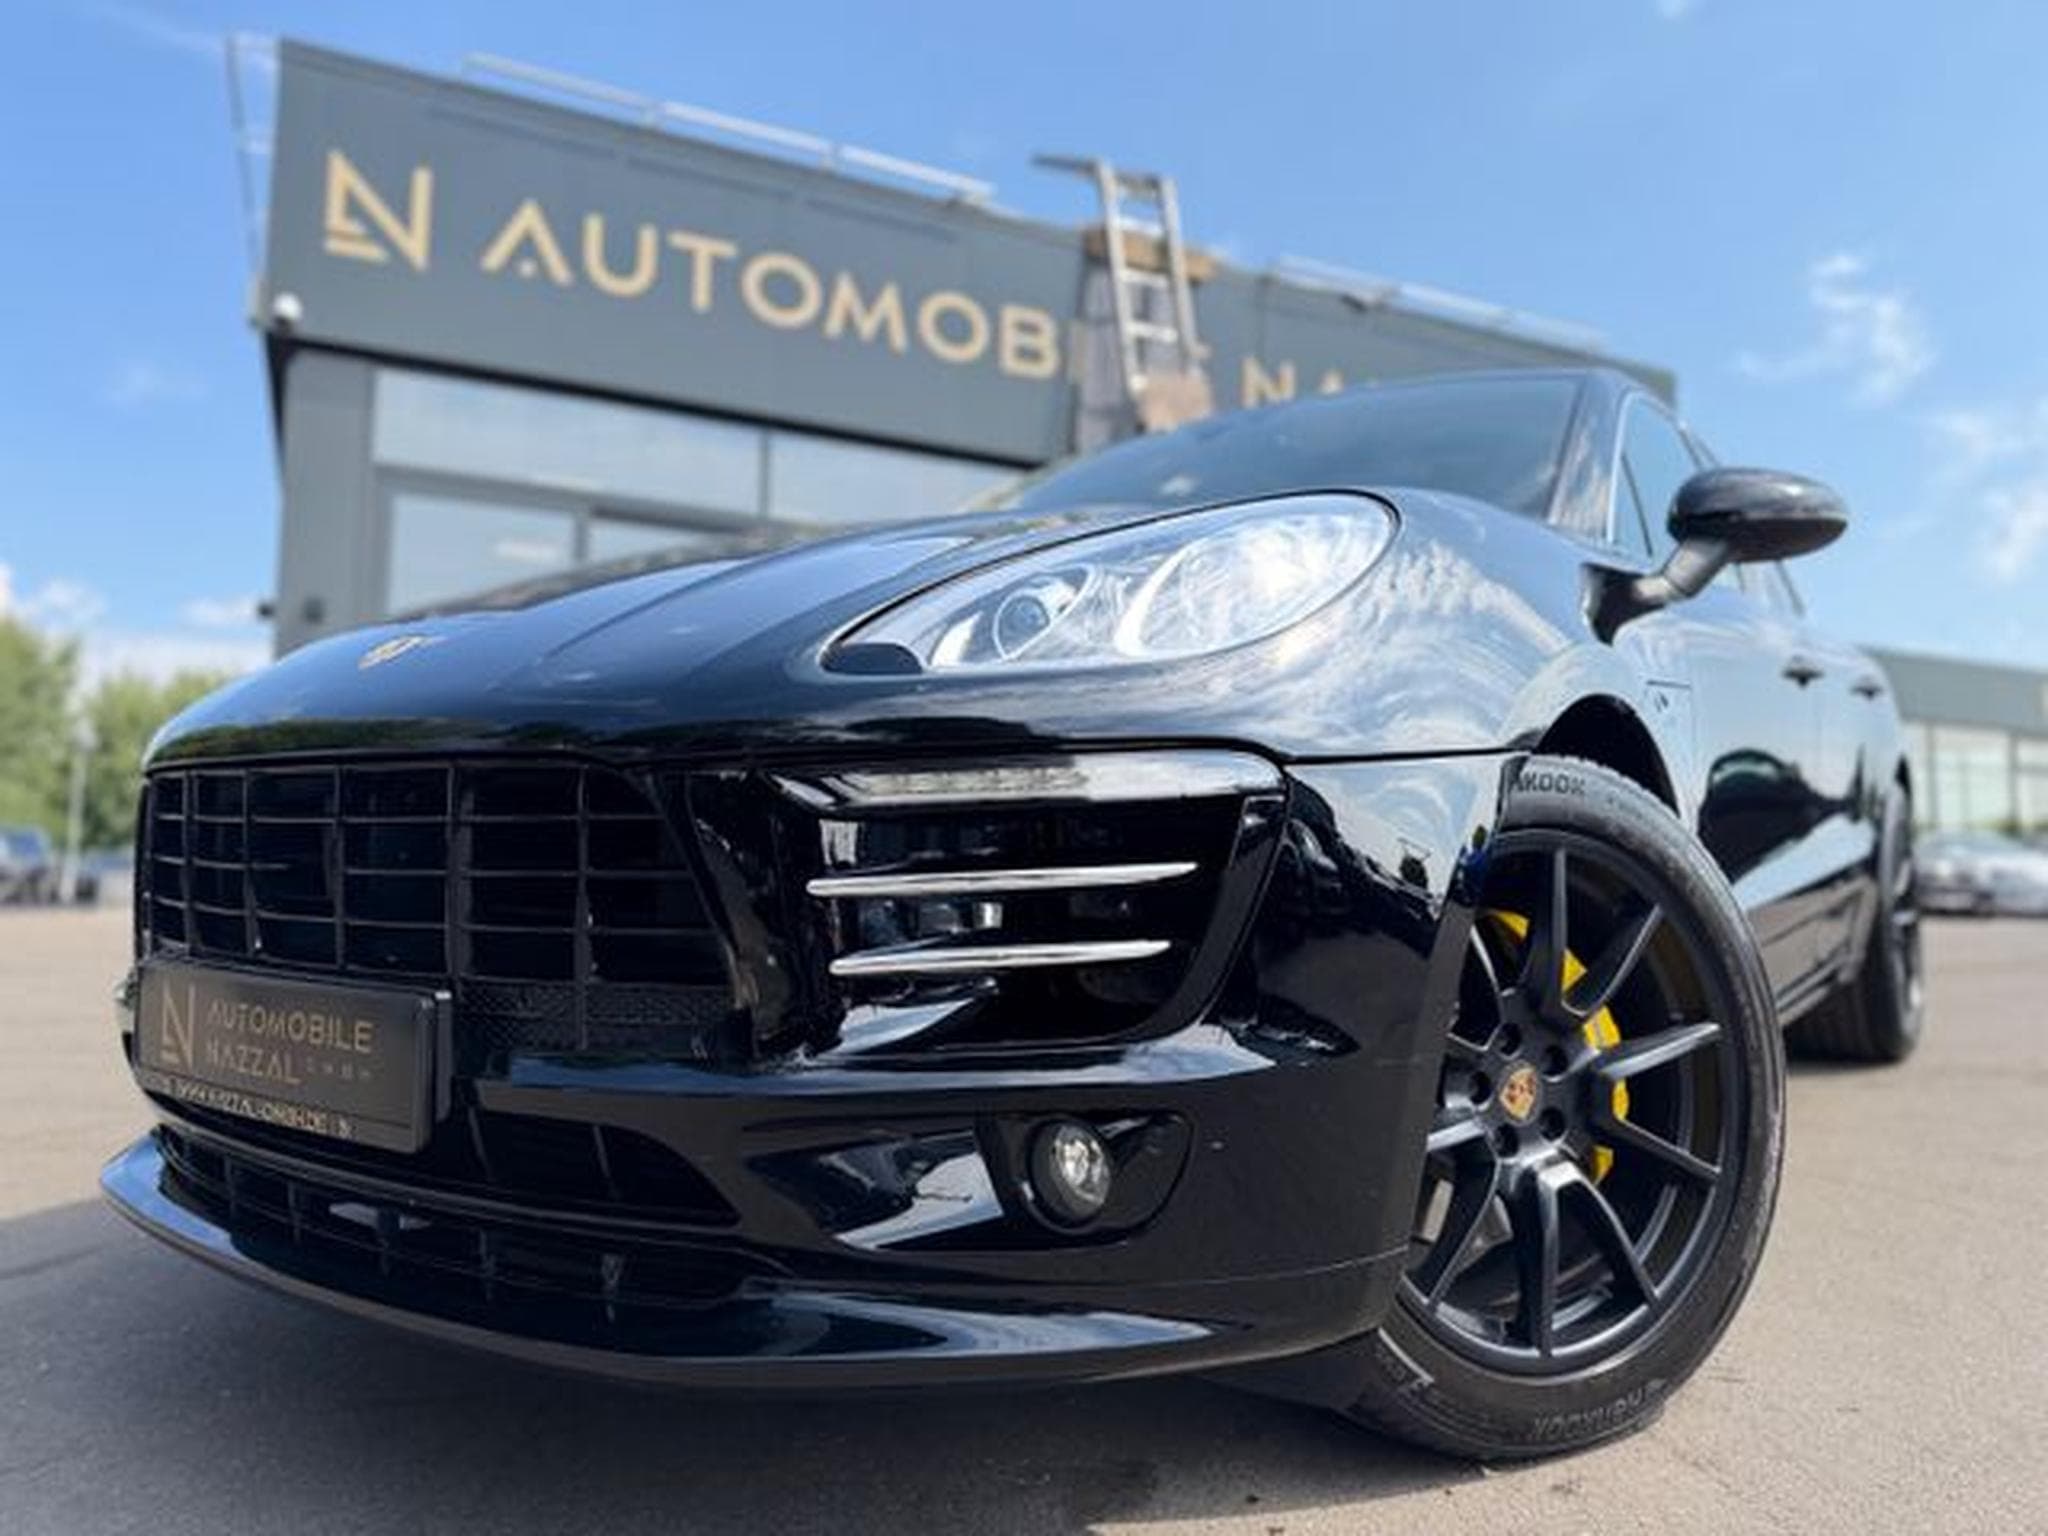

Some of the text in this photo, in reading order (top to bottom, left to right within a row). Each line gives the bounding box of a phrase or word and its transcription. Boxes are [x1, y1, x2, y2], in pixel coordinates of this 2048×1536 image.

[481, 200, 1060, 379] AUTOMOB
[205, 1001, 374, 1052] AUTOMOBILE
[206, 1040, 301, 1084] NAZZAL
